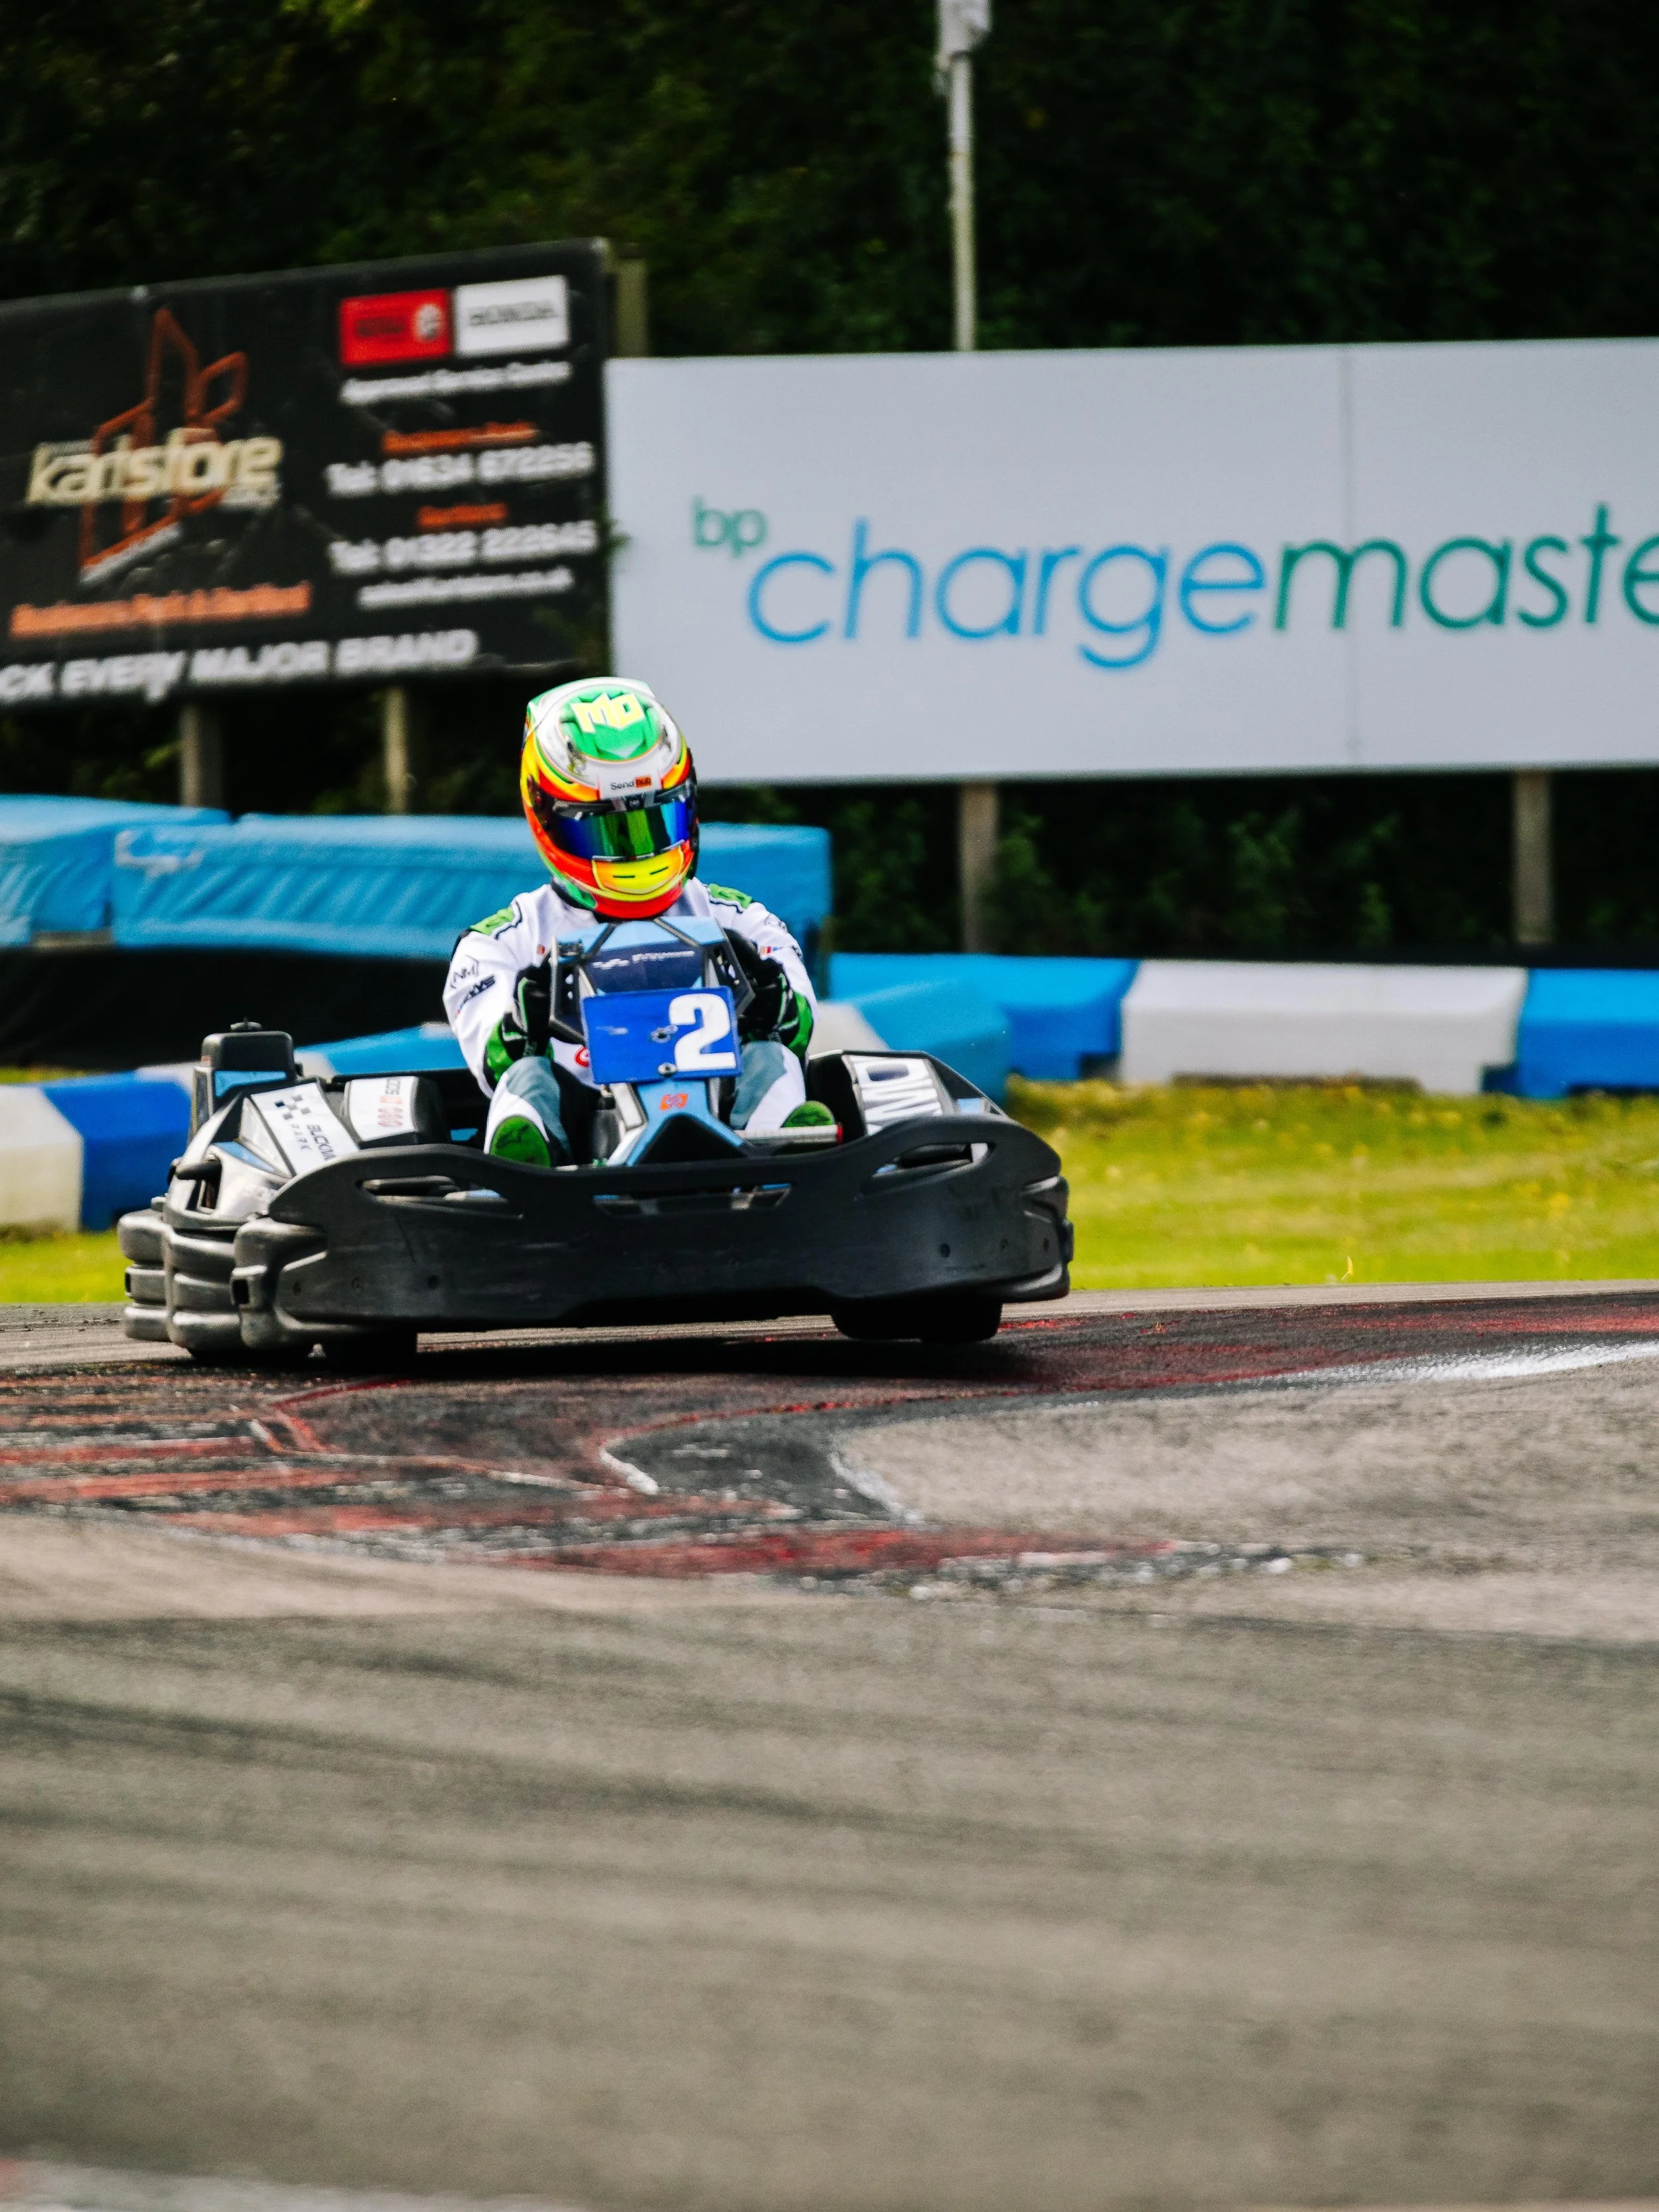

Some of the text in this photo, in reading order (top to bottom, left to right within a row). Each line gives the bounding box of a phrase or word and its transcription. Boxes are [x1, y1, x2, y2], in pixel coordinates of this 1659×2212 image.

[691, 495, 770, 559] bp
[189, 637, 330, 686] MAJOR
[334, 628, 480, 675] BRAND
[668, 992, 737, 1072] 2
